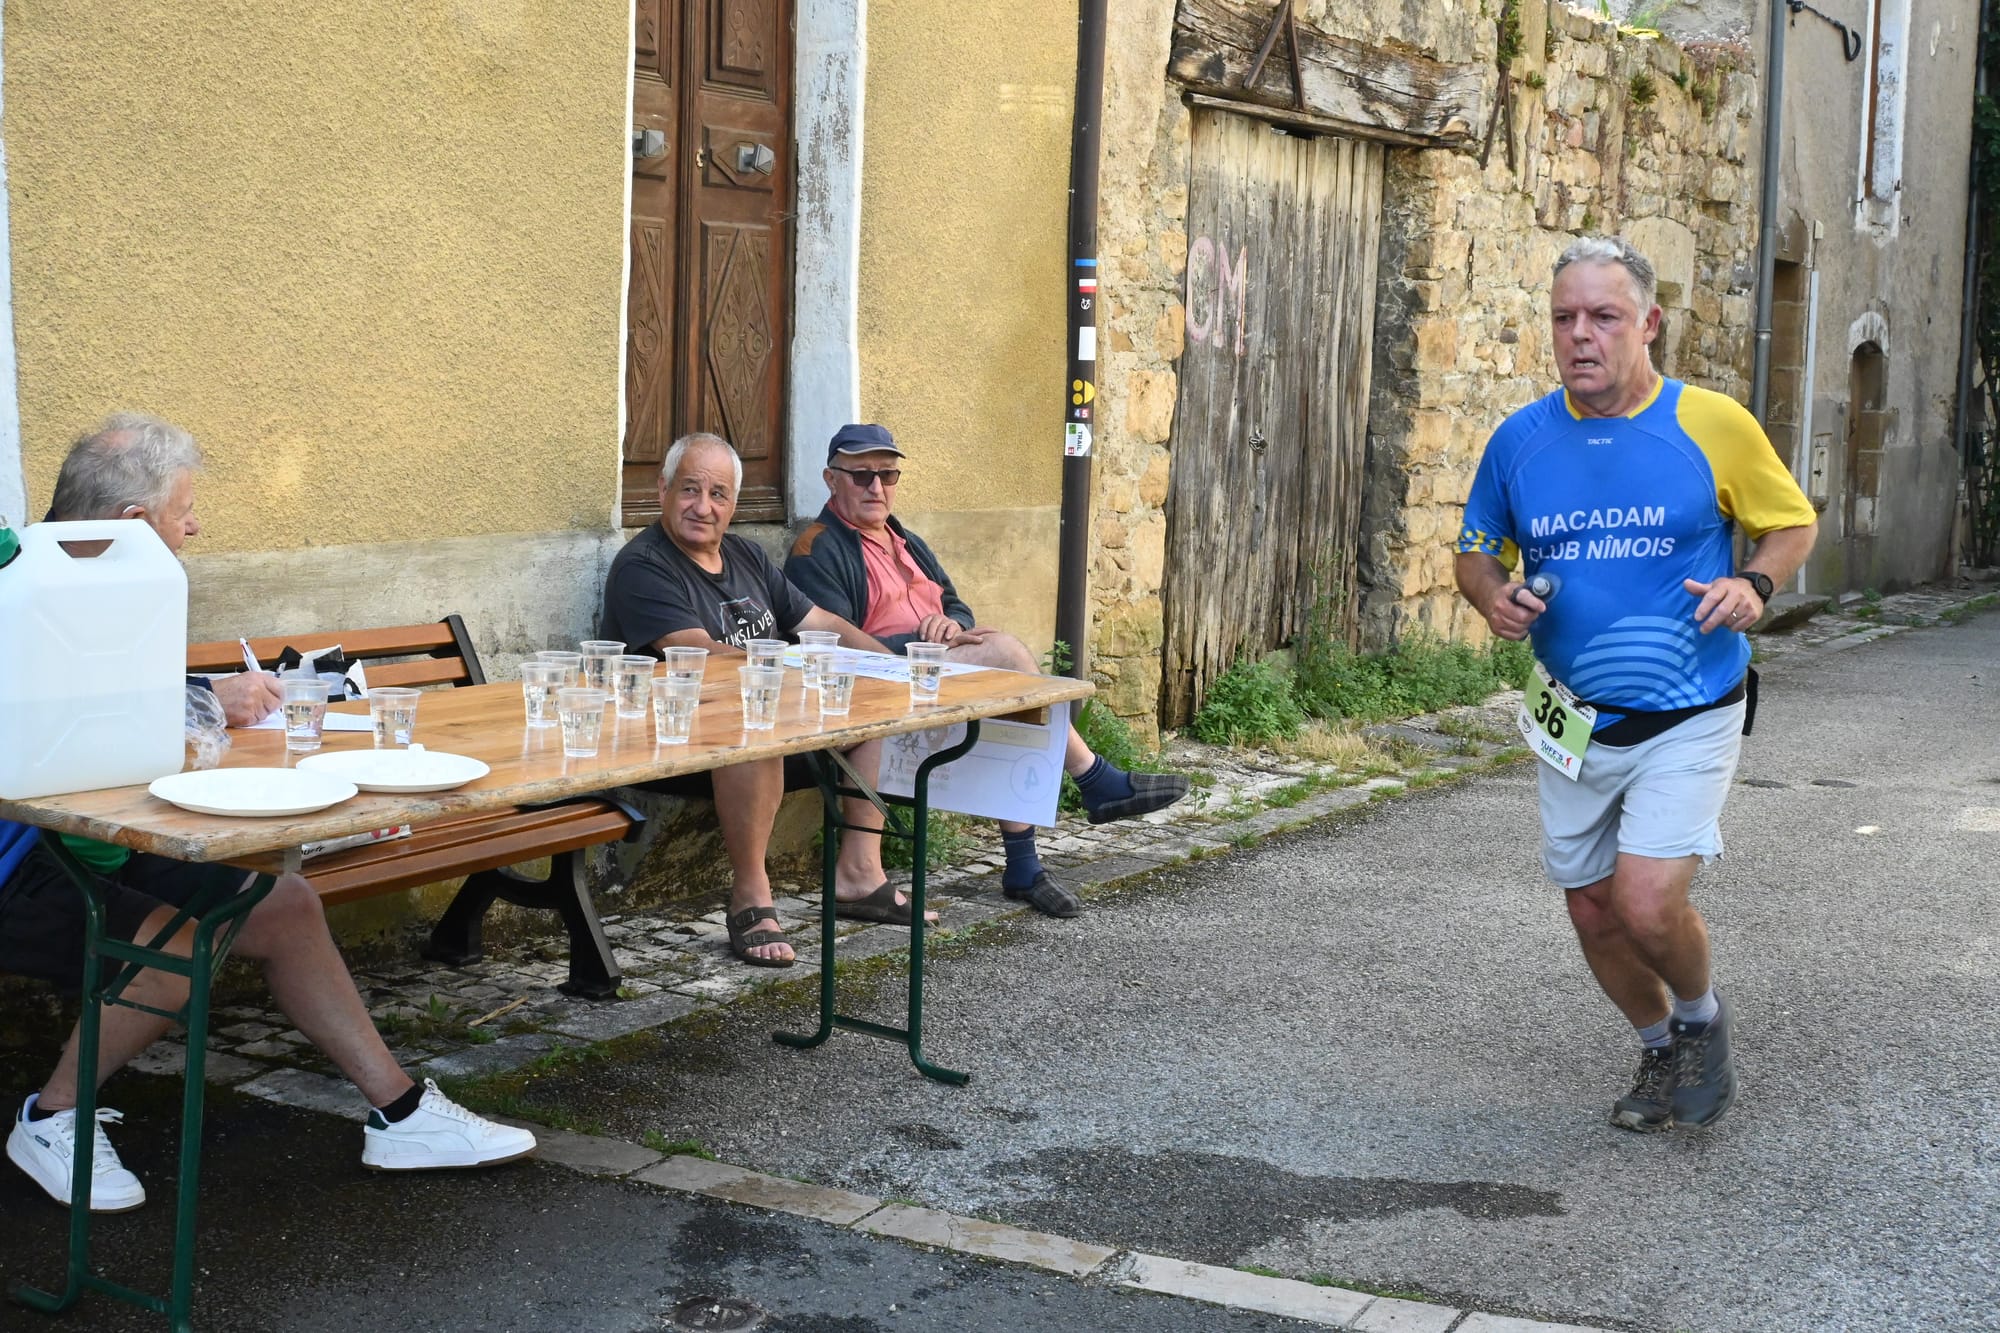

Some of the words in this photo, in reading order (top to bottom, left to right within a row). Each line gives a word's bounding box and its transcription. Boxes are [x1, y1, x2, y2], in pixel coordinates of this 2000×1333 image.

[1186, 236, 1247, 356] OM
[1531, 506, 1665, 538] MACADAM
[1529, 541, 1580, 562] CLUB
[1586, 535, 1675, 560] NÎMOIS
[1535, 691, 1567, 739] 36
